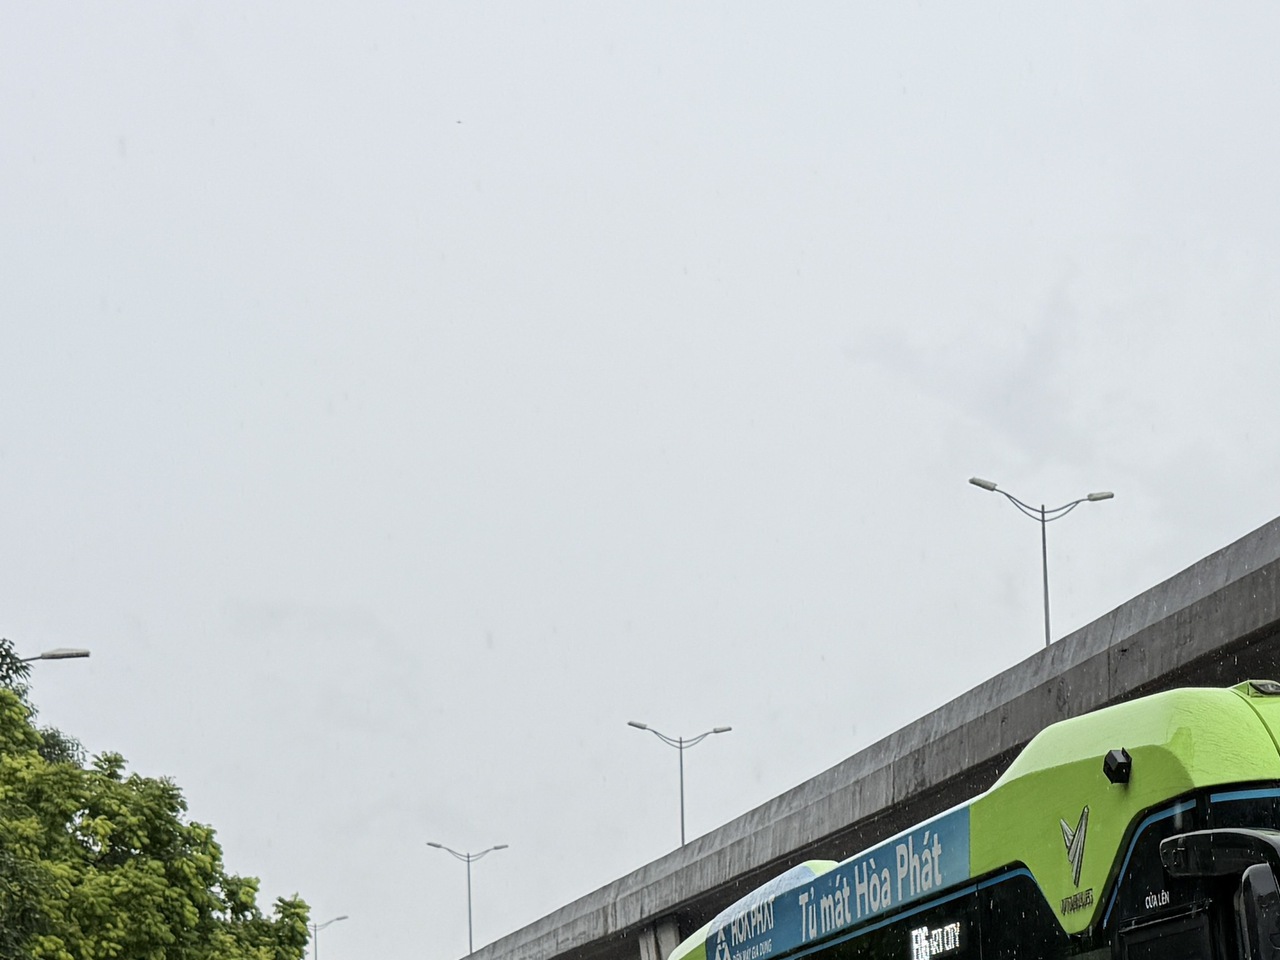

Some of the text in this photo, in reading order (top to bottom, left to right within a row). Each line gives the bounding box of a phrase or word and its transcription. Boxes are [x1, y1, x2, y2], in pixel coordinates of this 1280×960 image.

[799, 830, 942, 942] Tủ mát Hòa Phát
[1158, 889, 1170, 907] LÊN
